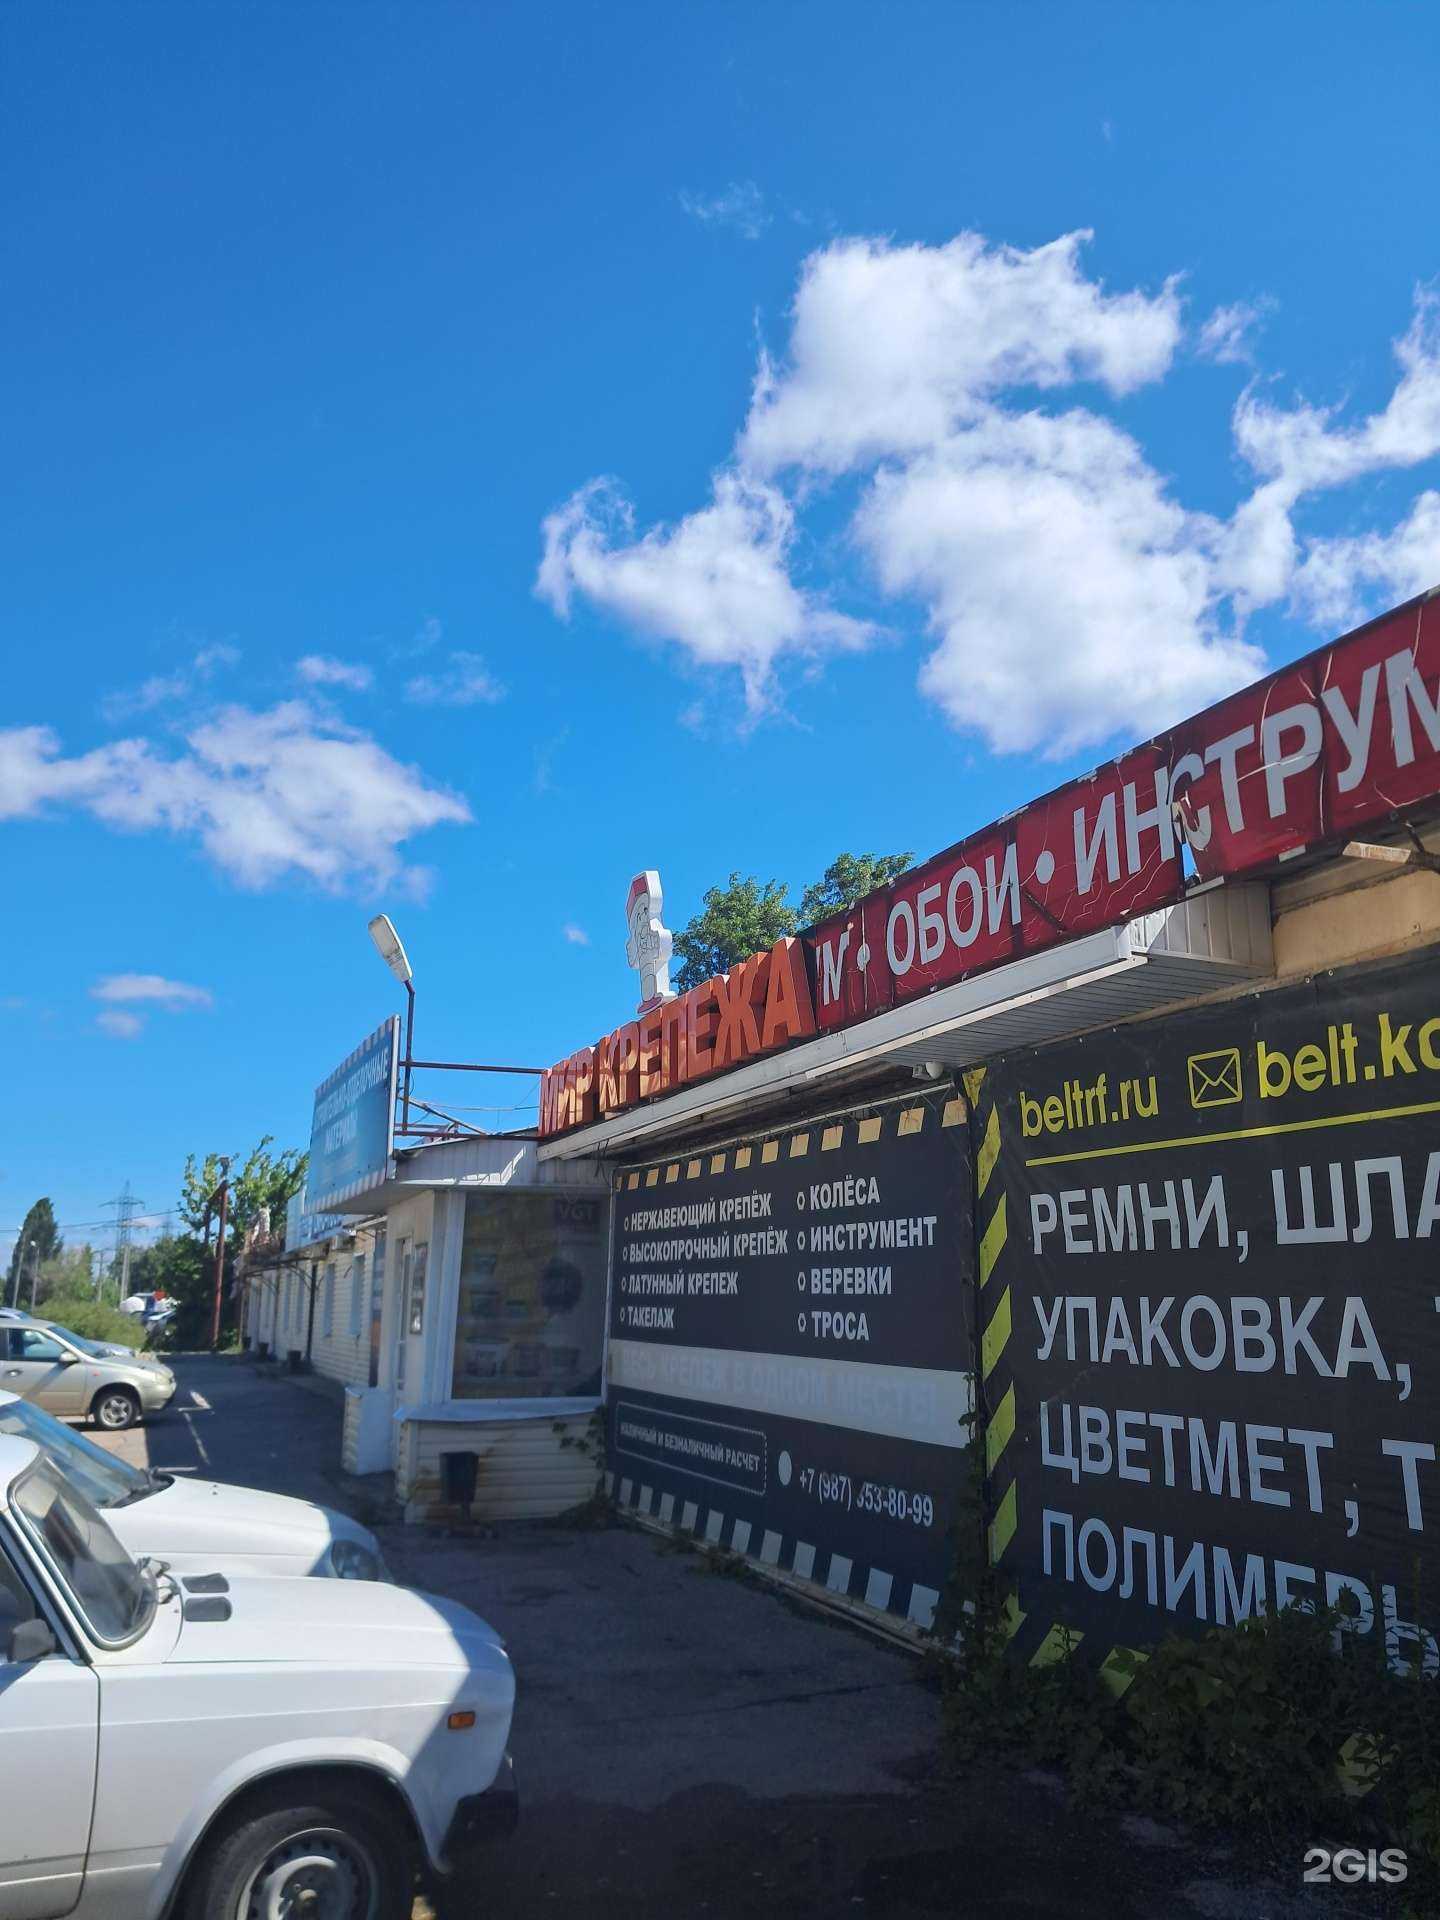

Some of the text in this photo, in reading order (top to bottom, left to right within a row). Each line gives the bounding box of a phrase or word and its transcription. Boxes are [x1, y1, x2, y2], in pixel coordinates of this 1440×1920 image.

[886, 843, 1022, 976] ОБОИ
[538, 937, 816, 1138] МИР КРЕПЕЖА
[1020, 1073, 1159, 1137] beltrf.ru
[631, 1190, 772, 1232] НЕРЖАВЕЮЩИЙ КРЕПЁЖ
[810, 1174, 880, 1211] КОЛЁСА
[810, 1216, 938, 1252] ИНСТРУМЕНТ
[1029, 1175, 1249, 1264] РЕМНИ,
[629, 1225, 788, 1263] ВЫСОКОПРОЧНЫЙ КРЕПЁЖ
[628, 1269, 739, 1296] ЛАТУННЫЙ КРЕПЕЖ
[810, 1266, 892, 1295] ВЕРЕВКИ
[627, 1306, 675, 1329] ТАКЕЛАЖ
[811, 1310, 870, 1341] ТРОСА
[1032, 1295, 1412, 1401] УПАКОВКА,
[664, 1432, 724, 1463] БЕЗНАЛИЧНЫЙ
[725, 1448, 761, 1473] РАСЧЕТ
[1040, 1401, 1360, 1537] ЦВЕТМЕТ,
[800, 1468, 815, 1494] +7
[818, 1471, 852, 1512] (987)
